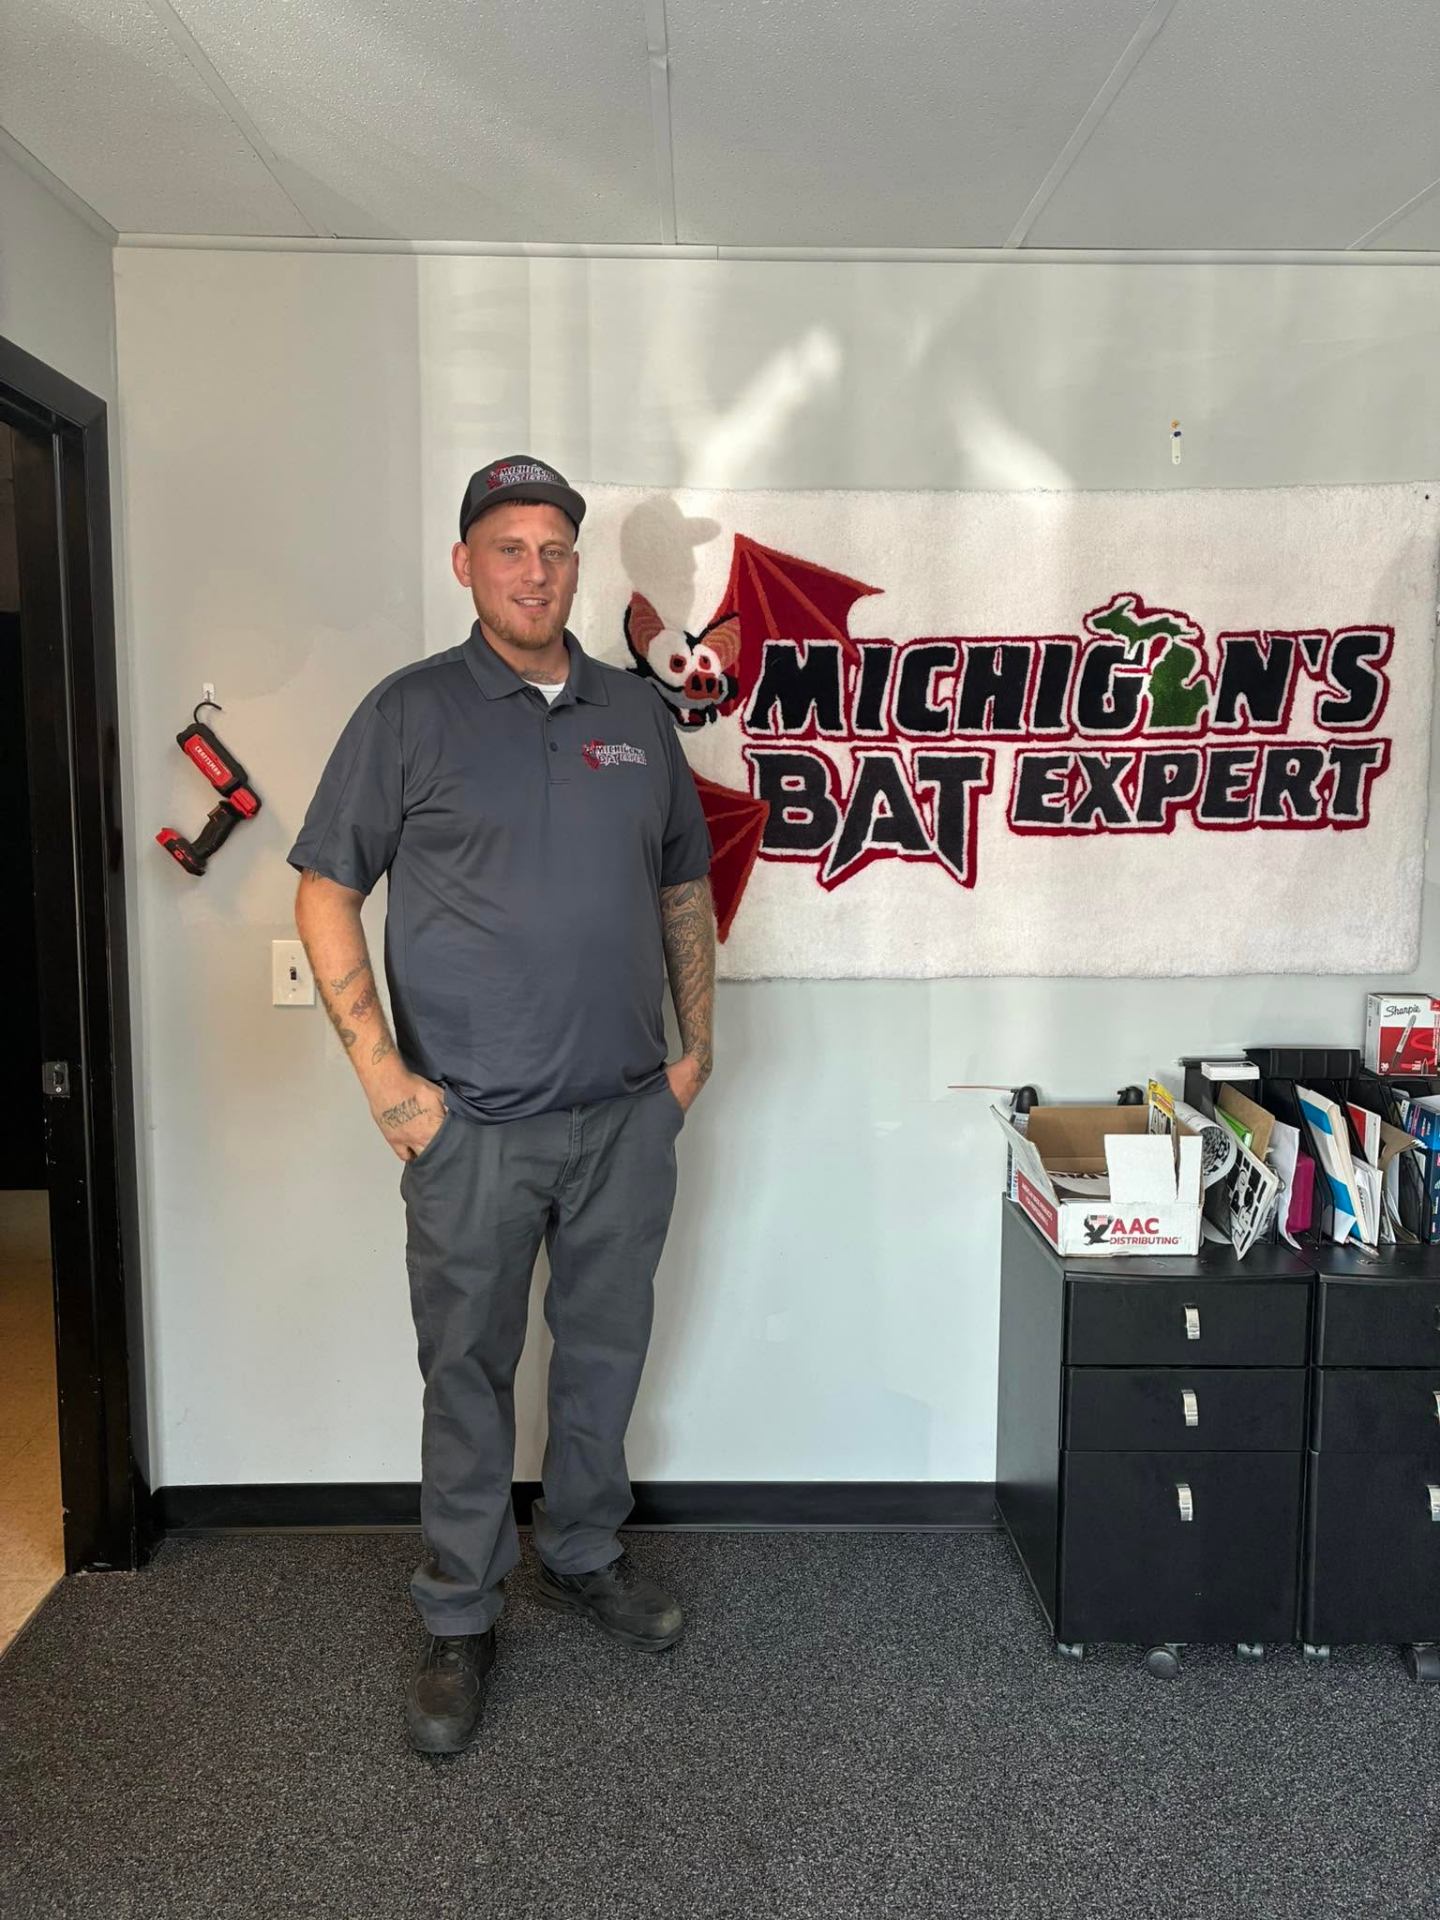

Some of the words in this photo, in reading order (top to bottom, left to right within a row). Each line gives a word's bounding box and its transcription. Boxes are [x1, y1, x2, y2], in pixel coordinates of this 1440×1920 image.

[743, 746, 995, 891] BAT
[1006, 740, 1391, 835] EXPERT
[1384, 1004, 1421, 1018] Sharpie
[1111, 1217, 1160, 1235] AAC
[1110, 1236, 1180, 1246] DISTRIBUTING
